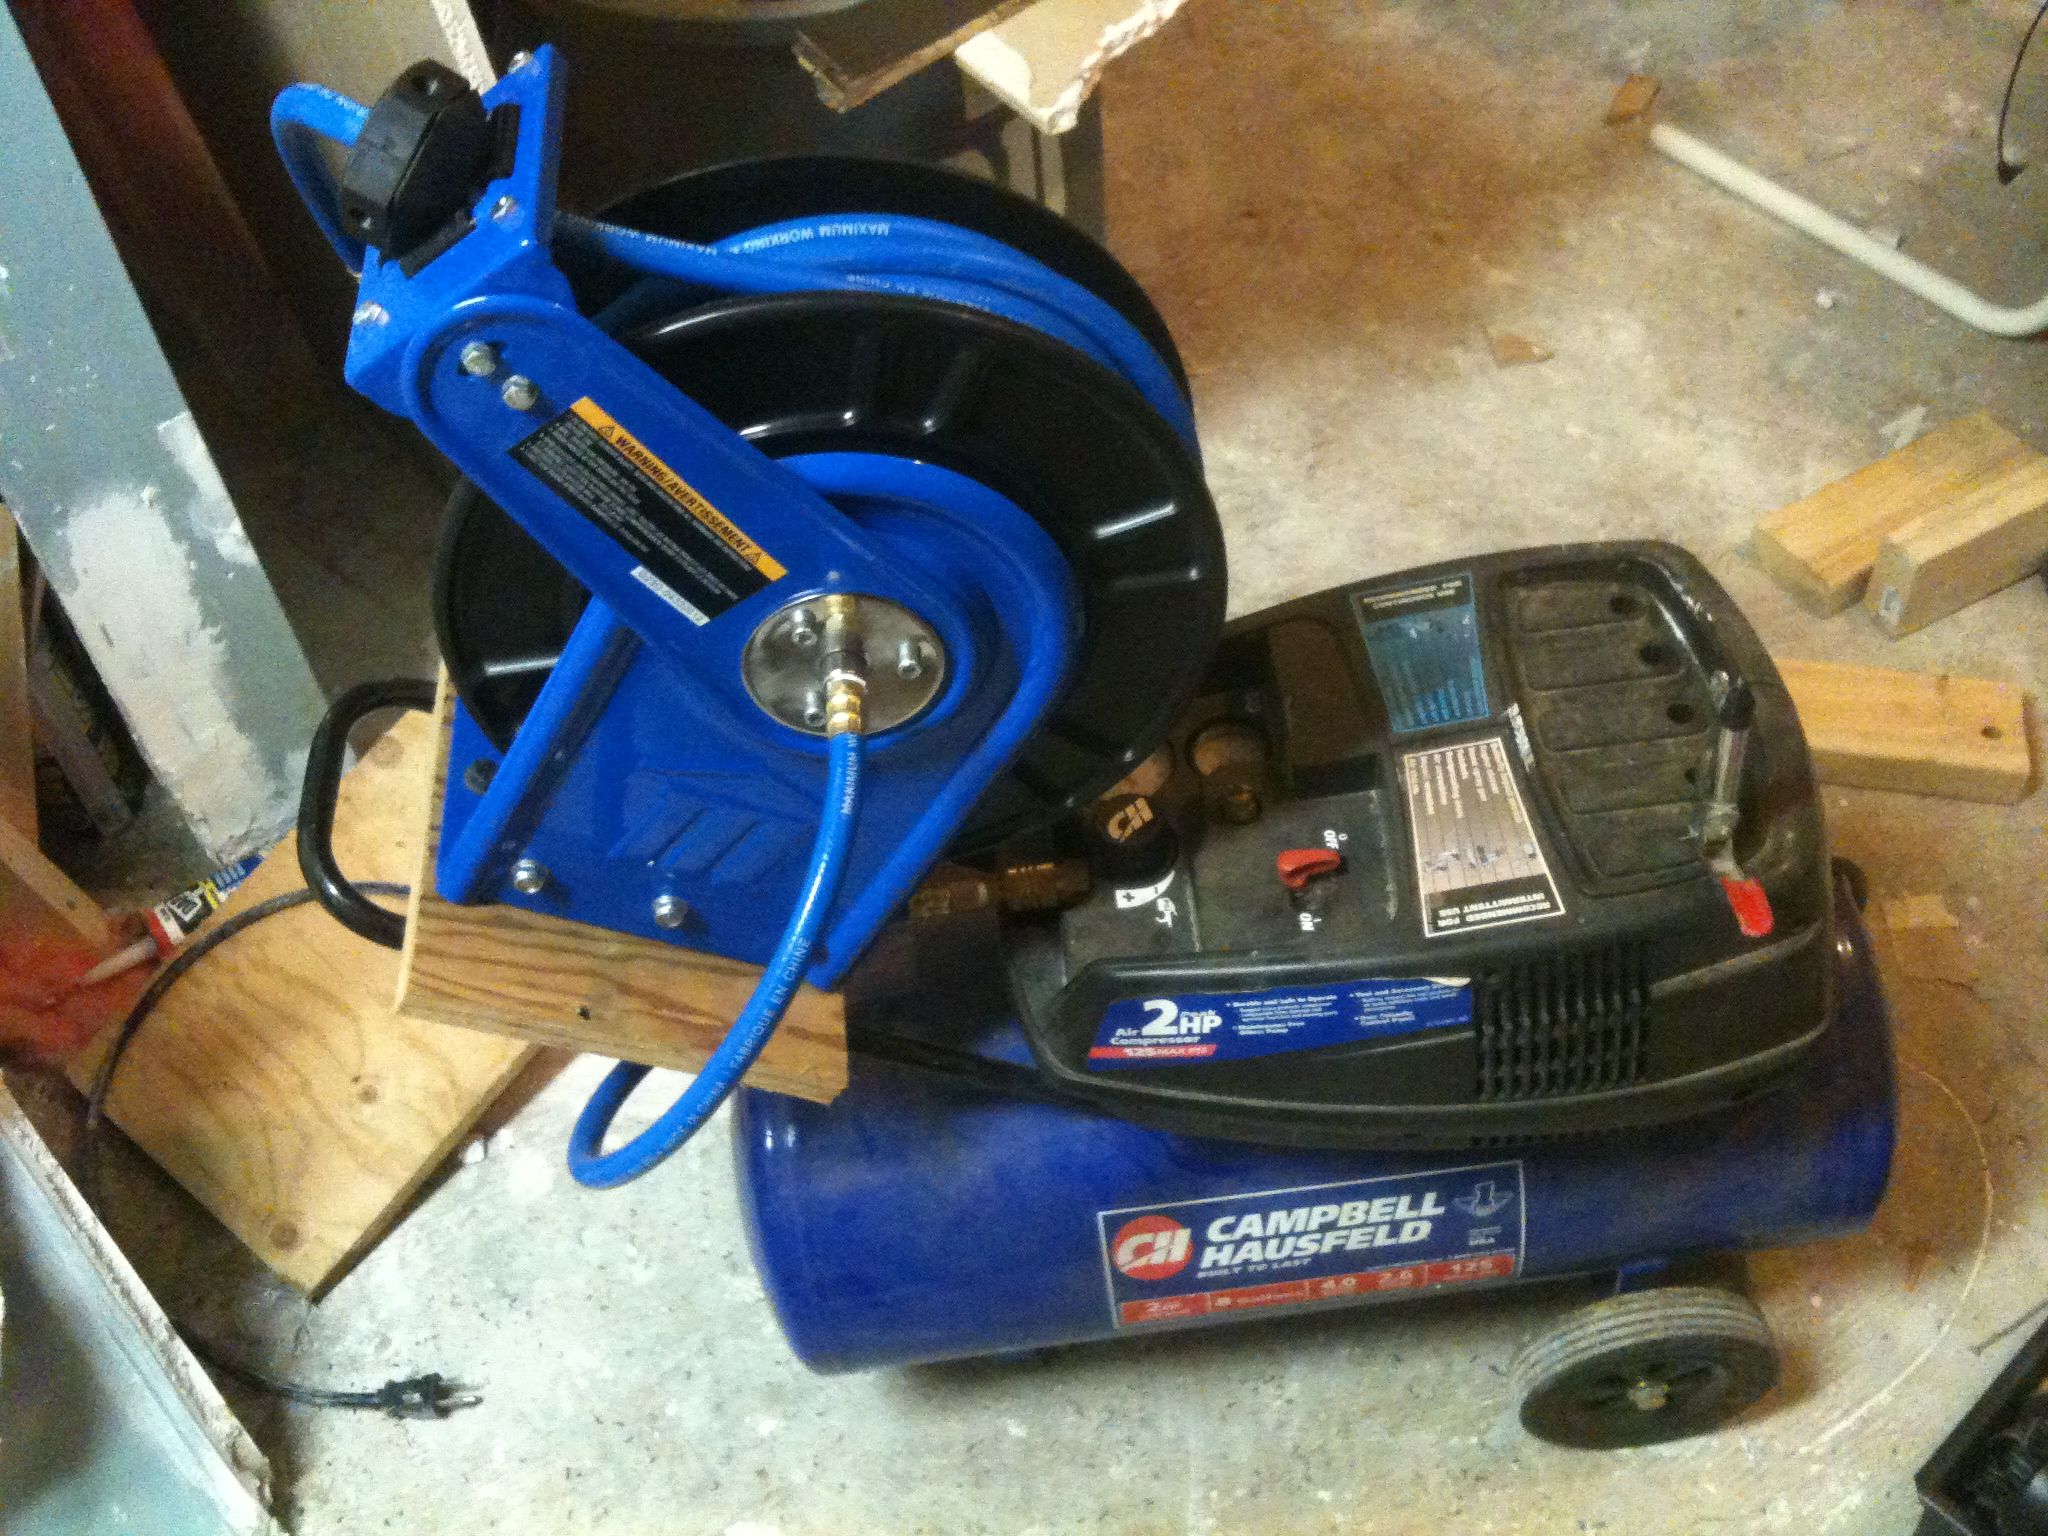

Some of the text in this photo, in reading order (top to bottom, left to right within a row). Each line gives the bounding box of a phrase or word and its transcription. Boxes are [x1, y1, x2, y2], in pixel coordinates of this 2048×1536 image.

[819, 221, 890, 237] MAXIMUM
[1299, 912, 1315, 931] ON
[1141, 999, 1222, 1036] 2 HP
[1115, 1028, 1140, 1037] Air
[1206, 1191, 1446, 1242] CAMPBELL
[1200, 1220, 1433, 1270] HAUSFELD
